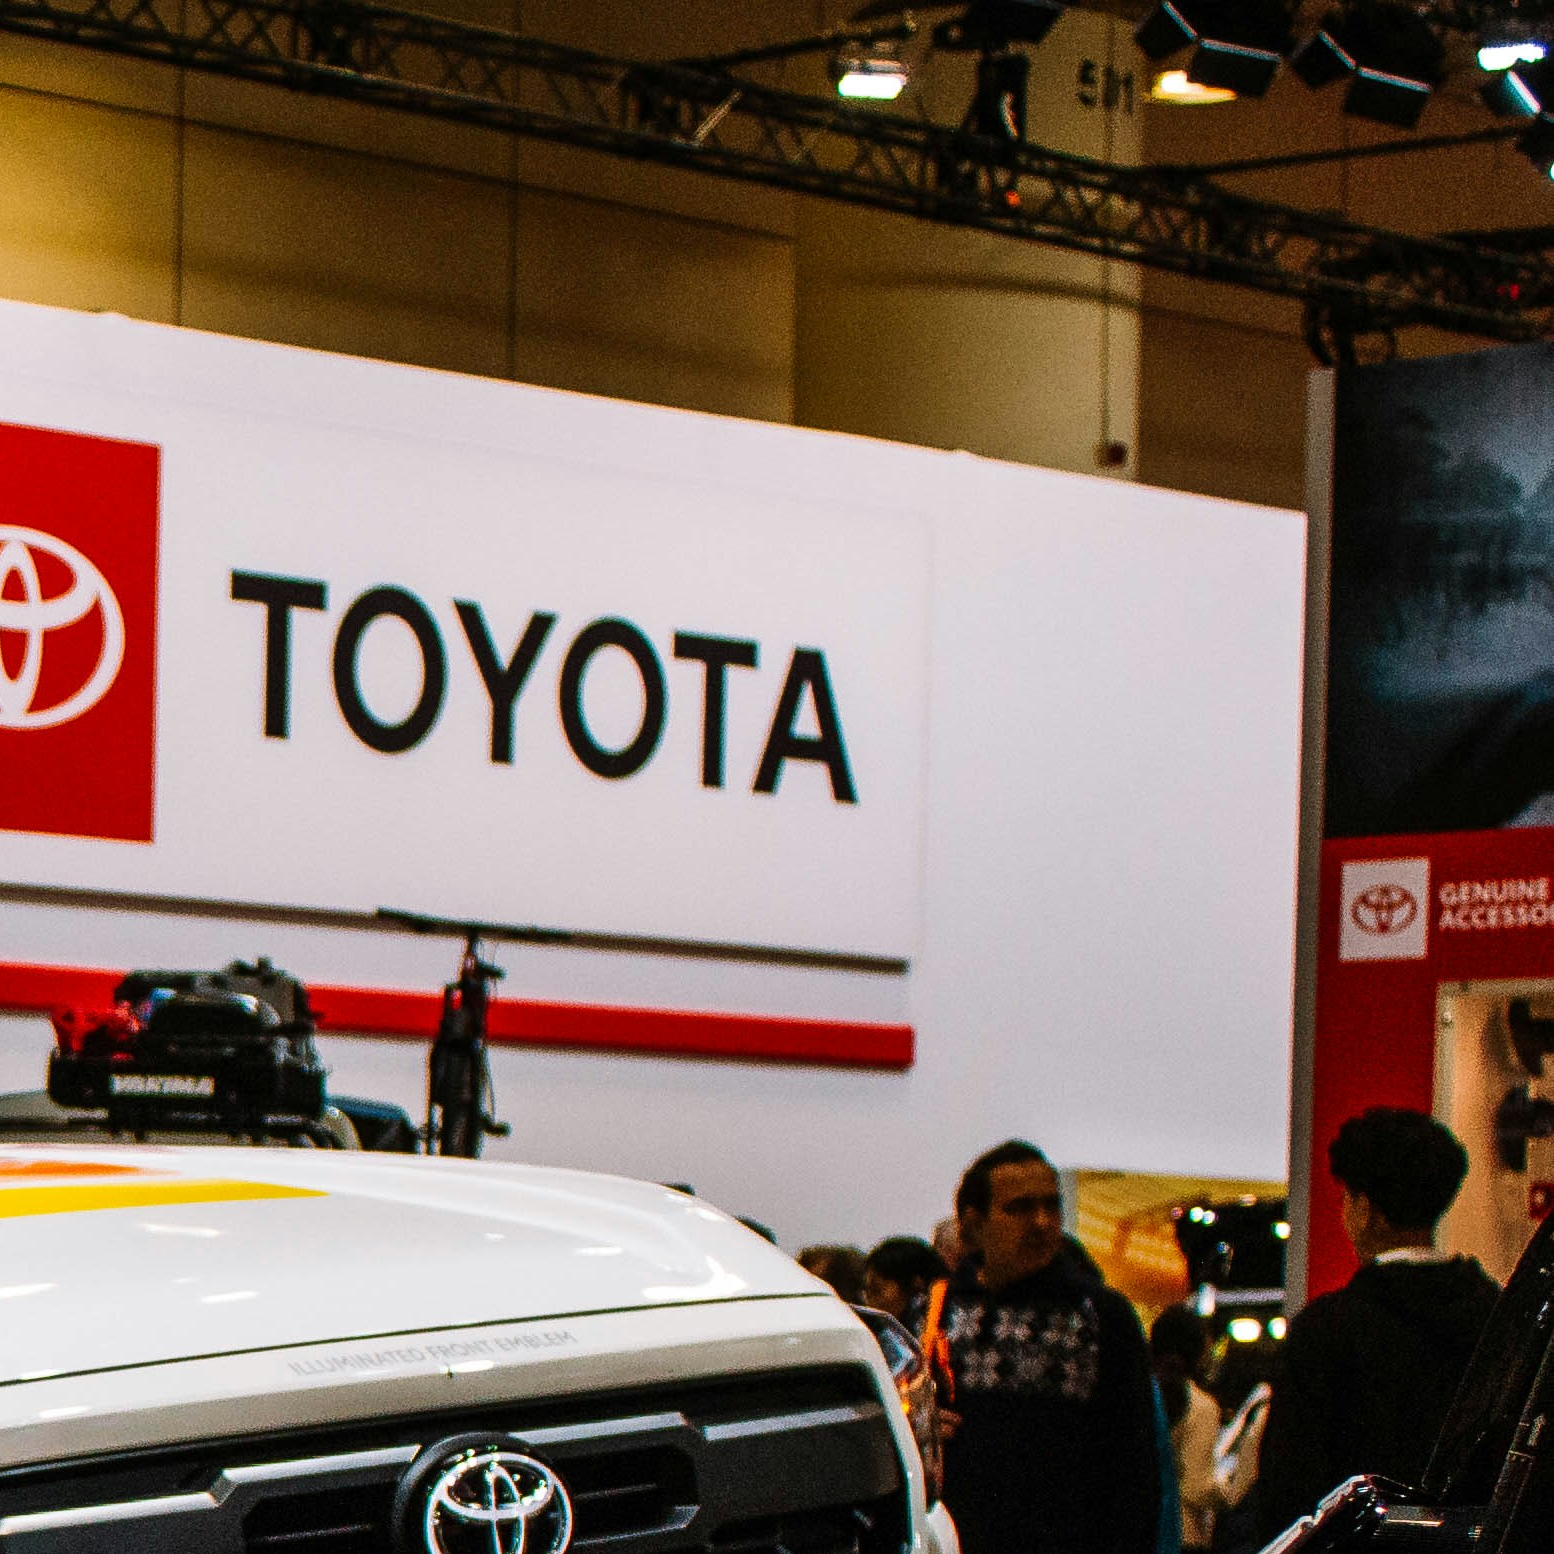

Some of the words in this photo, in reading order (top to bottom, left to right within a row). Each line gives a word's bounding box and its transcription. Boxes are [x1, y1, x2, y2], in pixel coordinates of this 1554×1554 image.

[230, 568, 859, 805] TOYOTA
[1439, 877, 1549, 905] GENUINE
[288, 1346, 424, 1376] ILLUMINATED
[426, 1339, 492, 1361] FRONT
[493, 1330, 579, 1352] EMBLEM
